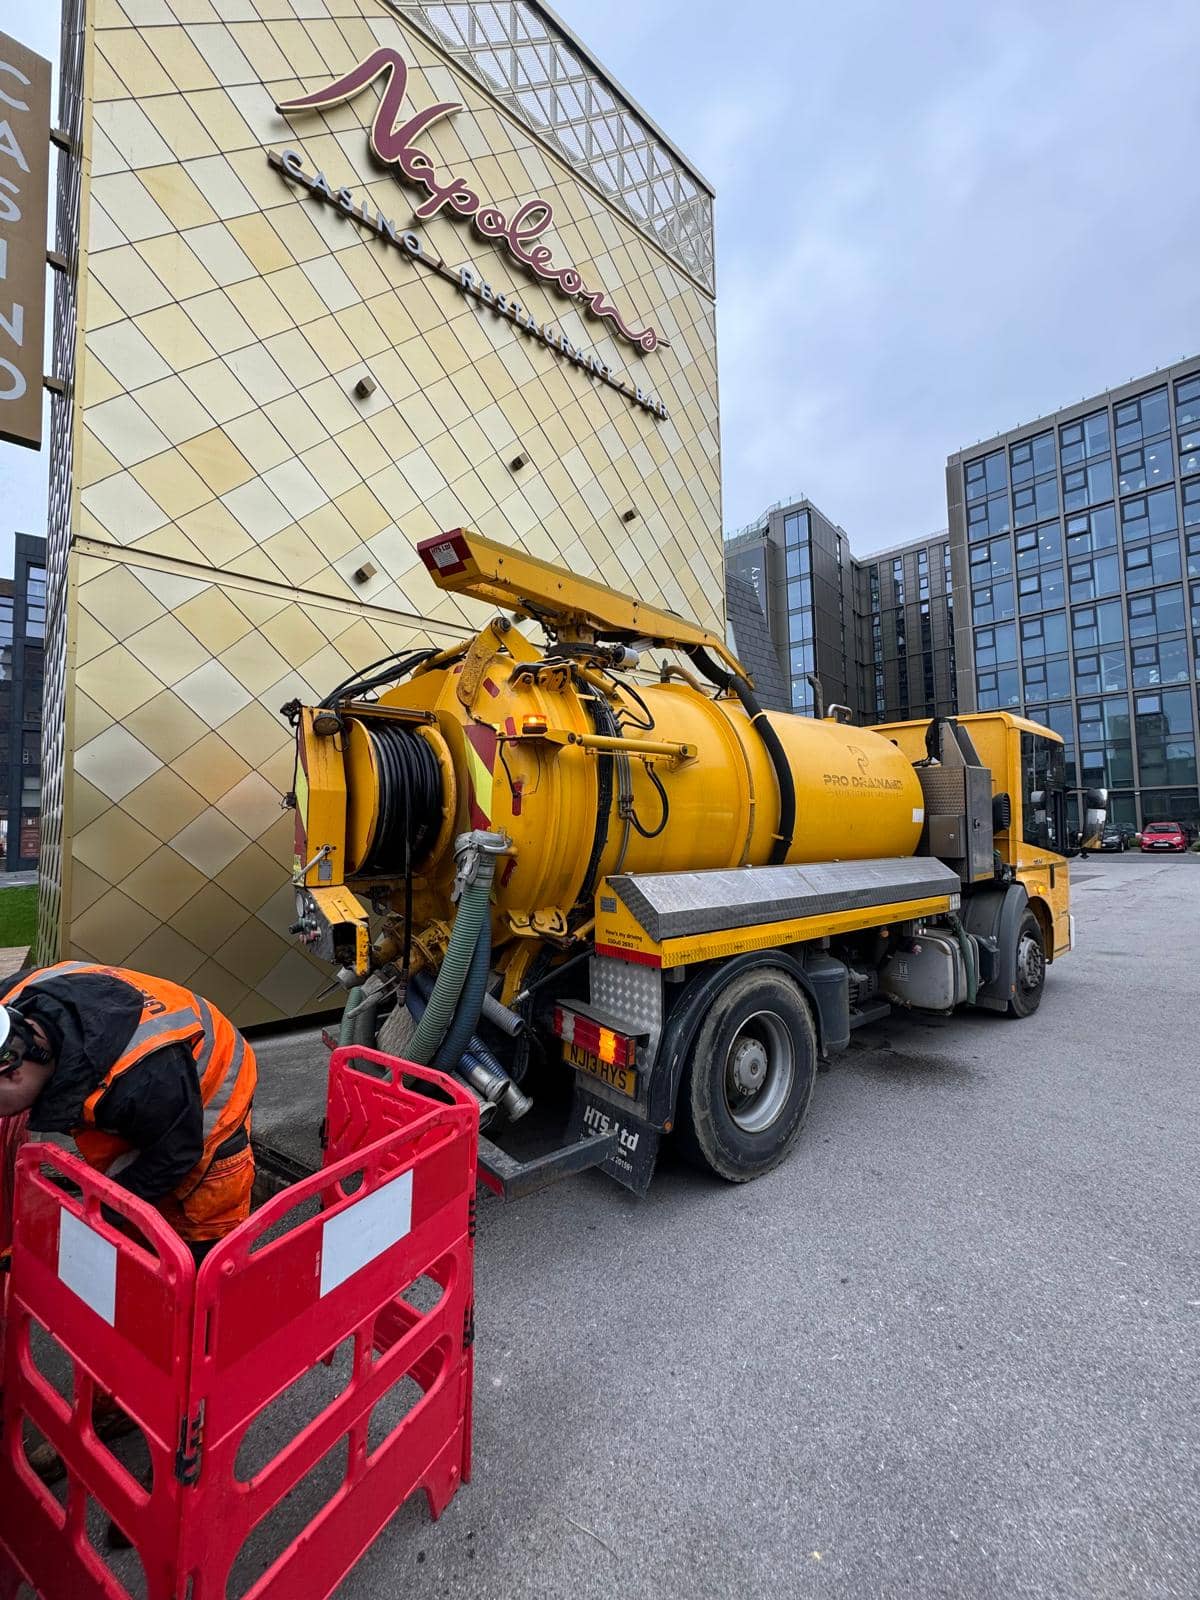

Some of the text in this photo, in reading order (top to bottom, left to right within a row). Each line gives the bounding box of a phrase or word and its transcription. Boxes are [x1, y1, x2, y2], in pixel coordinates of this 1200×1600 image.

[277, 47, 671, 352] Napoleons
[281, 148, 669, 419] CASINO RESTAURANT BAR
[823, 774, 849, 786] PRO
[569, 1044, 627, 1090] NJ13 HYS
[584, 1105, 610, 1133] HTS
